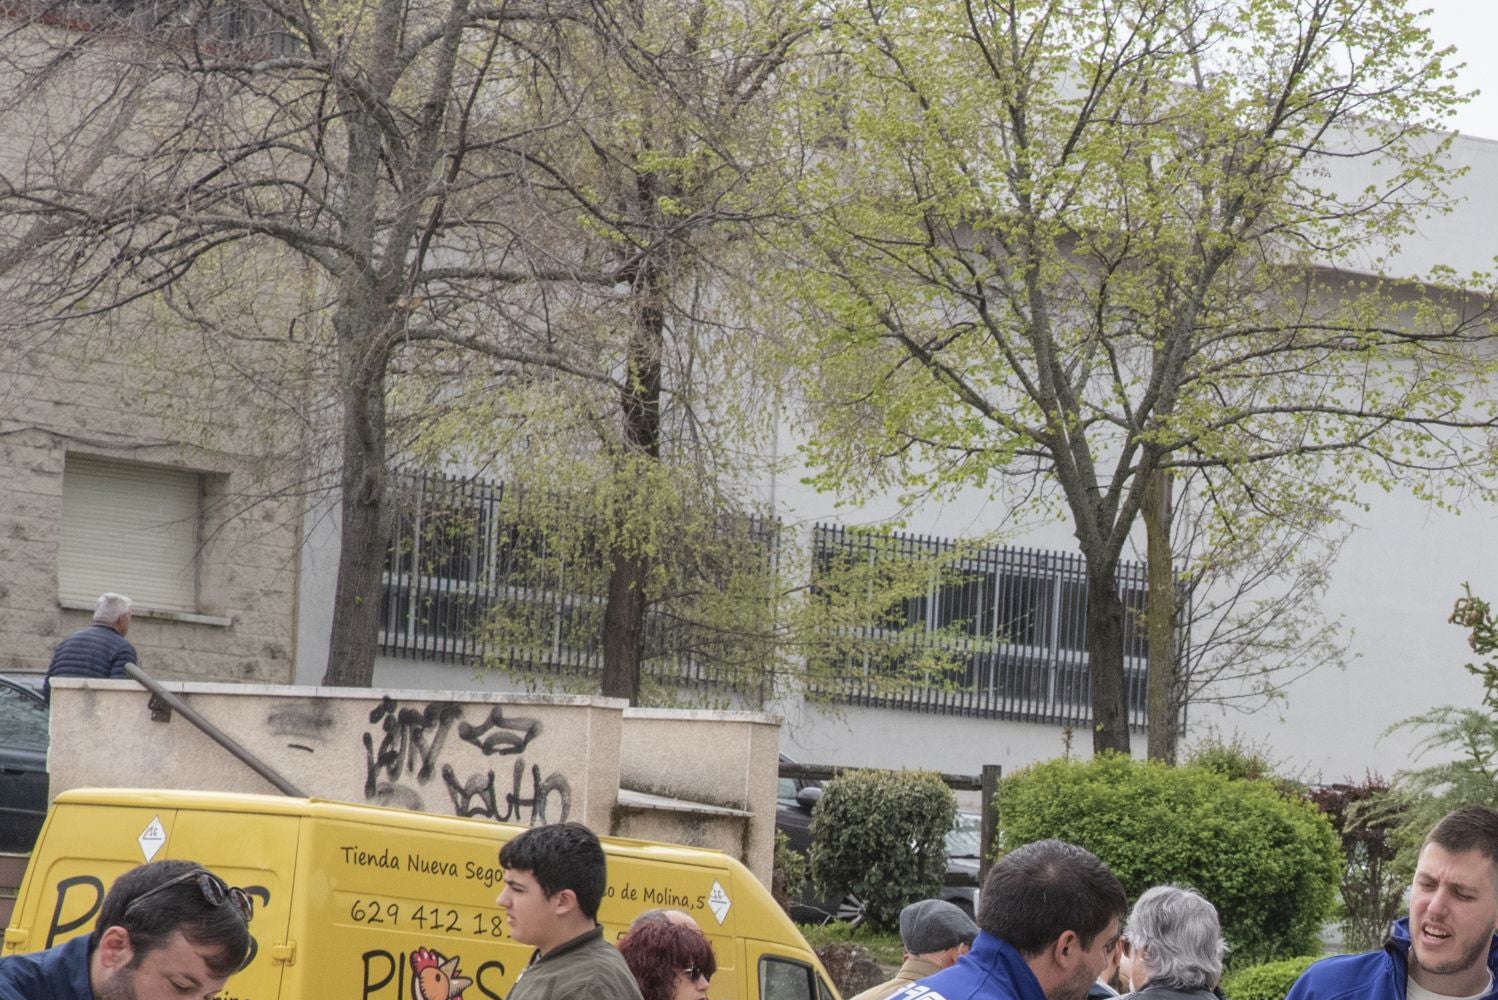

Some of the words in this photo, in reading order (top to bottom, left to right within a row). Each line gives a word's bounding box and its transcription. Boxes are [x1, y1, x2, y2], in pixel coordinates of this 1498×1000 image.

[340, 846, 399, 871] Tienda
[407, 854, 458, 879] Nueva
[465, 861, 504, 888] Sego
[621, 882, 638, 901] de
[350, 899, 399, 926] 629
[411, 904, 462, 933] 412
[473, 912, 512, 938] 18
